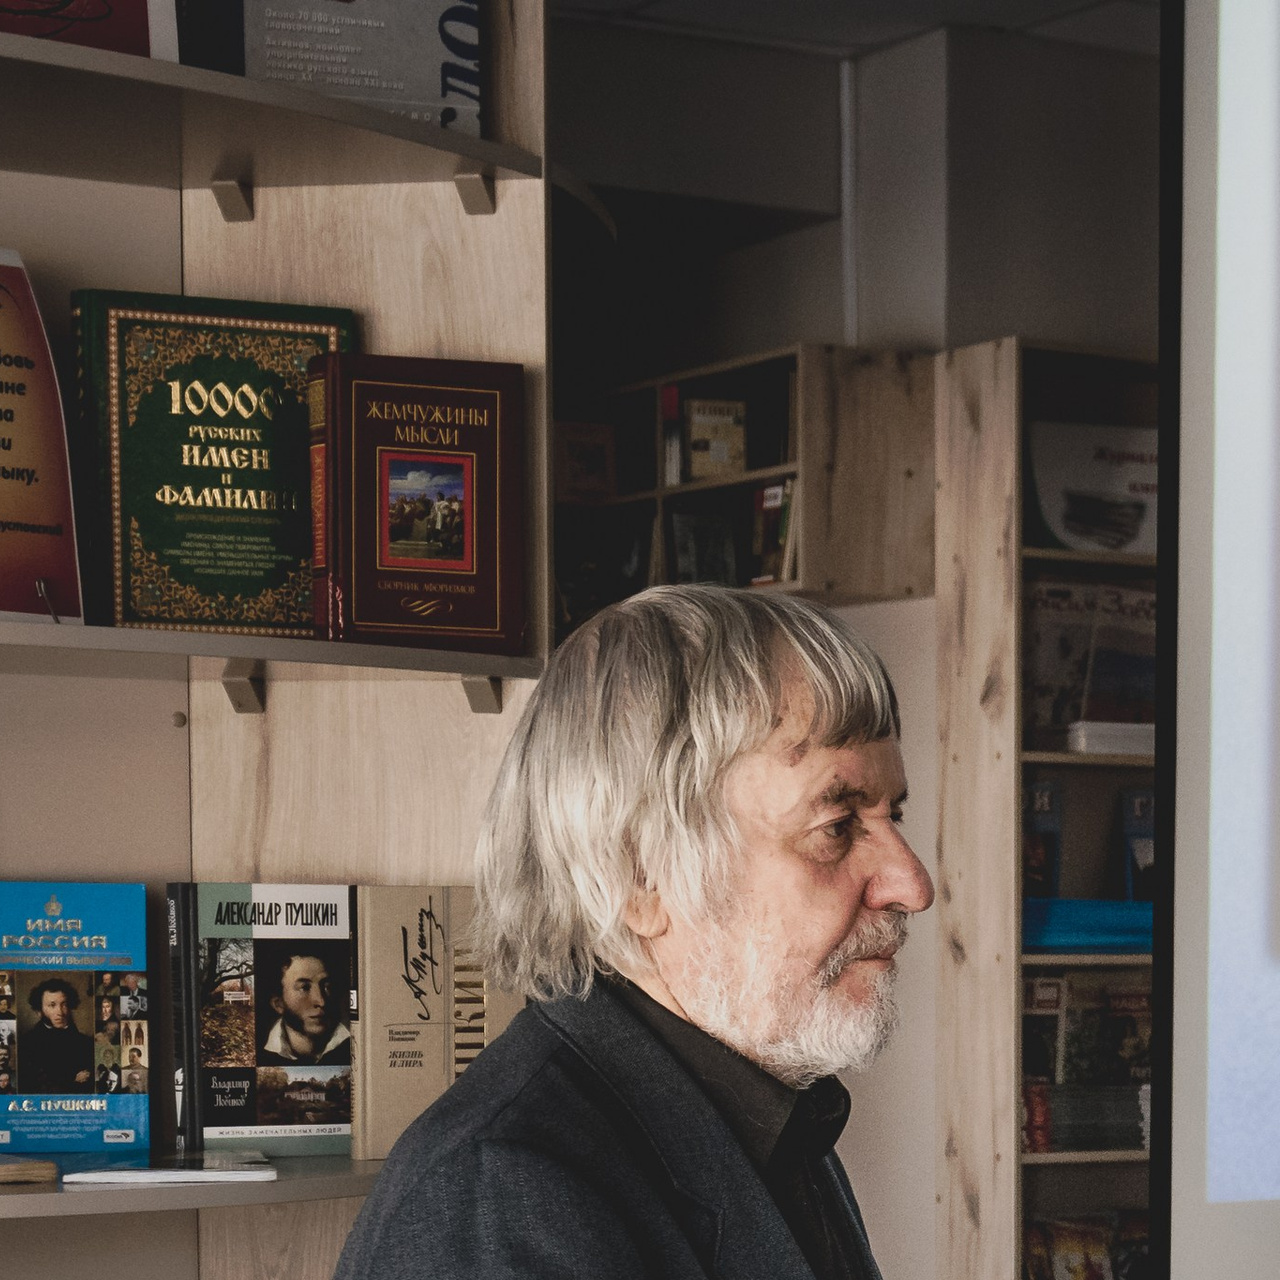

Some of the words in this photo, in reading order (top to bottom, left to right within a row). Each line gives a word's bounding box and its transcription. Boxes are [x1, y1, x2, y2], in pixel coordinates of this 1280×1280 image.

[366, 400, 489, 427] ЖЕМЧУЖИНЫ
[394, 424, 459, 446] МЫСЛИ
[180, 443, 271, 471] ИМЕН
[155, 484, 297, 511] ФАМИЛИ
[214, 901, 282, 926] АЛЕКСАНДР
[285, 902, 338, 927] ПУШКИН
[26, 918, 82, 932] ИМЯ
[2, 935, 107, 949] РОССИЯ
[210, 1075, 251, 1093] Владимир
[41, 1099, 107, 1112] ПУШКИН
[249, 1128, 313, 1136] ЗАМЕЧАТЕЛЬНЫХ
